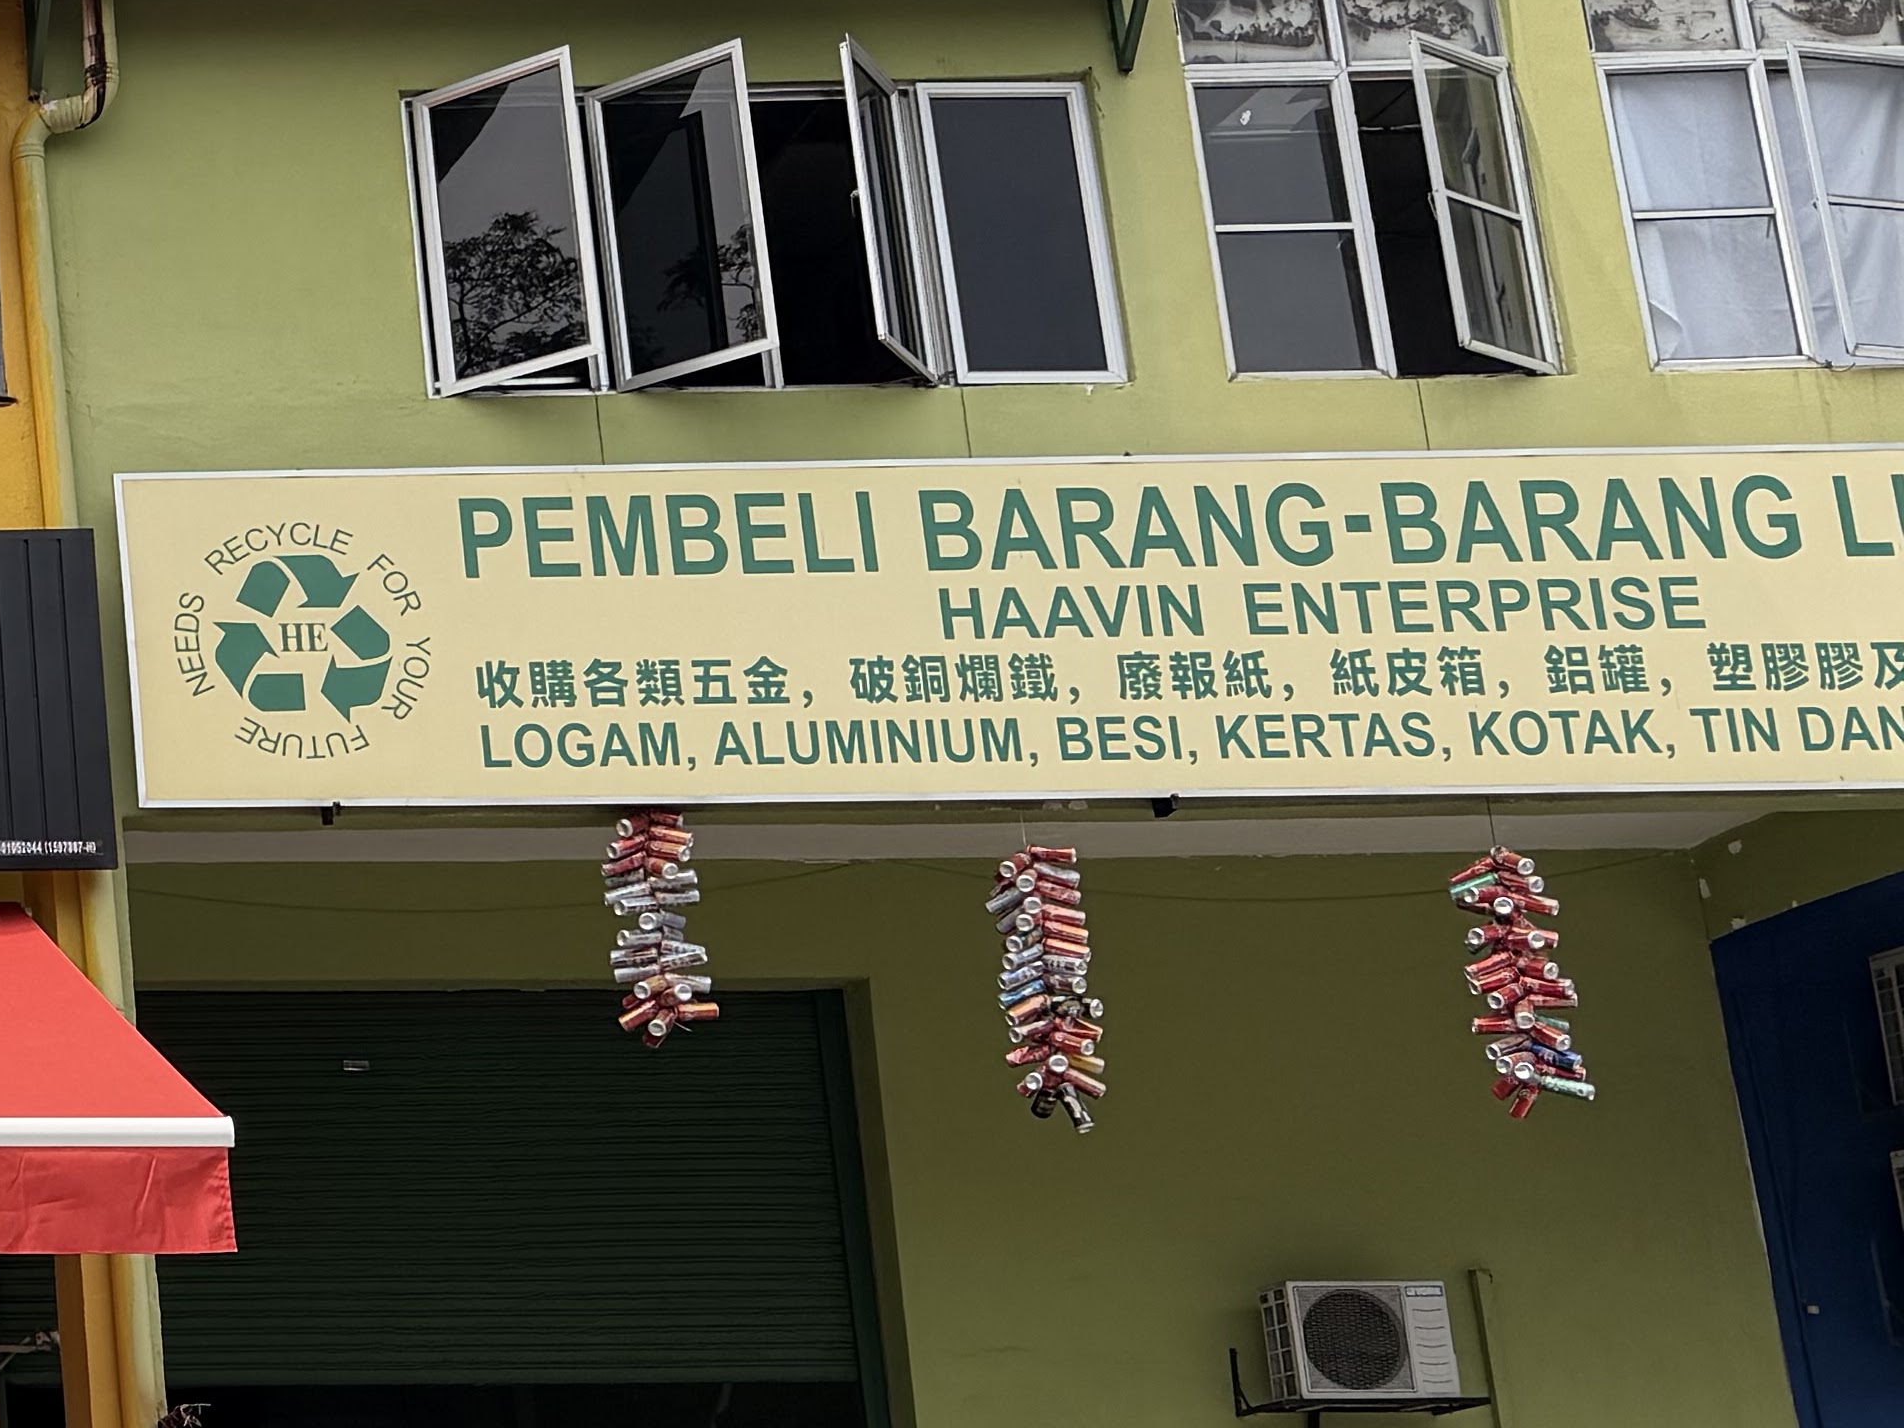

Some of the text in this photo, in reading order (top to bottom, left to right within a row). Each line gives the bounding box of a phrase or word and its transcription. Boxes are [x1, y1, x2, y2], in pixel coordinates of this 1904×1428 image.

[457, 490, 880, 579] PEMBELI
[918, 474, 1804, 574] BARANG-BARANG
[278, 622, 329, 652] HE
[939, 575, 1707, 640] HAAVIN ENTERPRISE
[174, 522, 432, 759] RECYCLE FOR YOUR FUTURE NEEDS
[480, 723, 696, 771] LOGAM,
[714, 718, 1040, 768] ALUMINIUM,
[1057, 715, 1198, 764] BESI,
[1216, 712, 1453, 761] KERTAS,
[1469, 709, 1676, 758] KOTAK,
[1690, 707, 1779, 753] TIN
